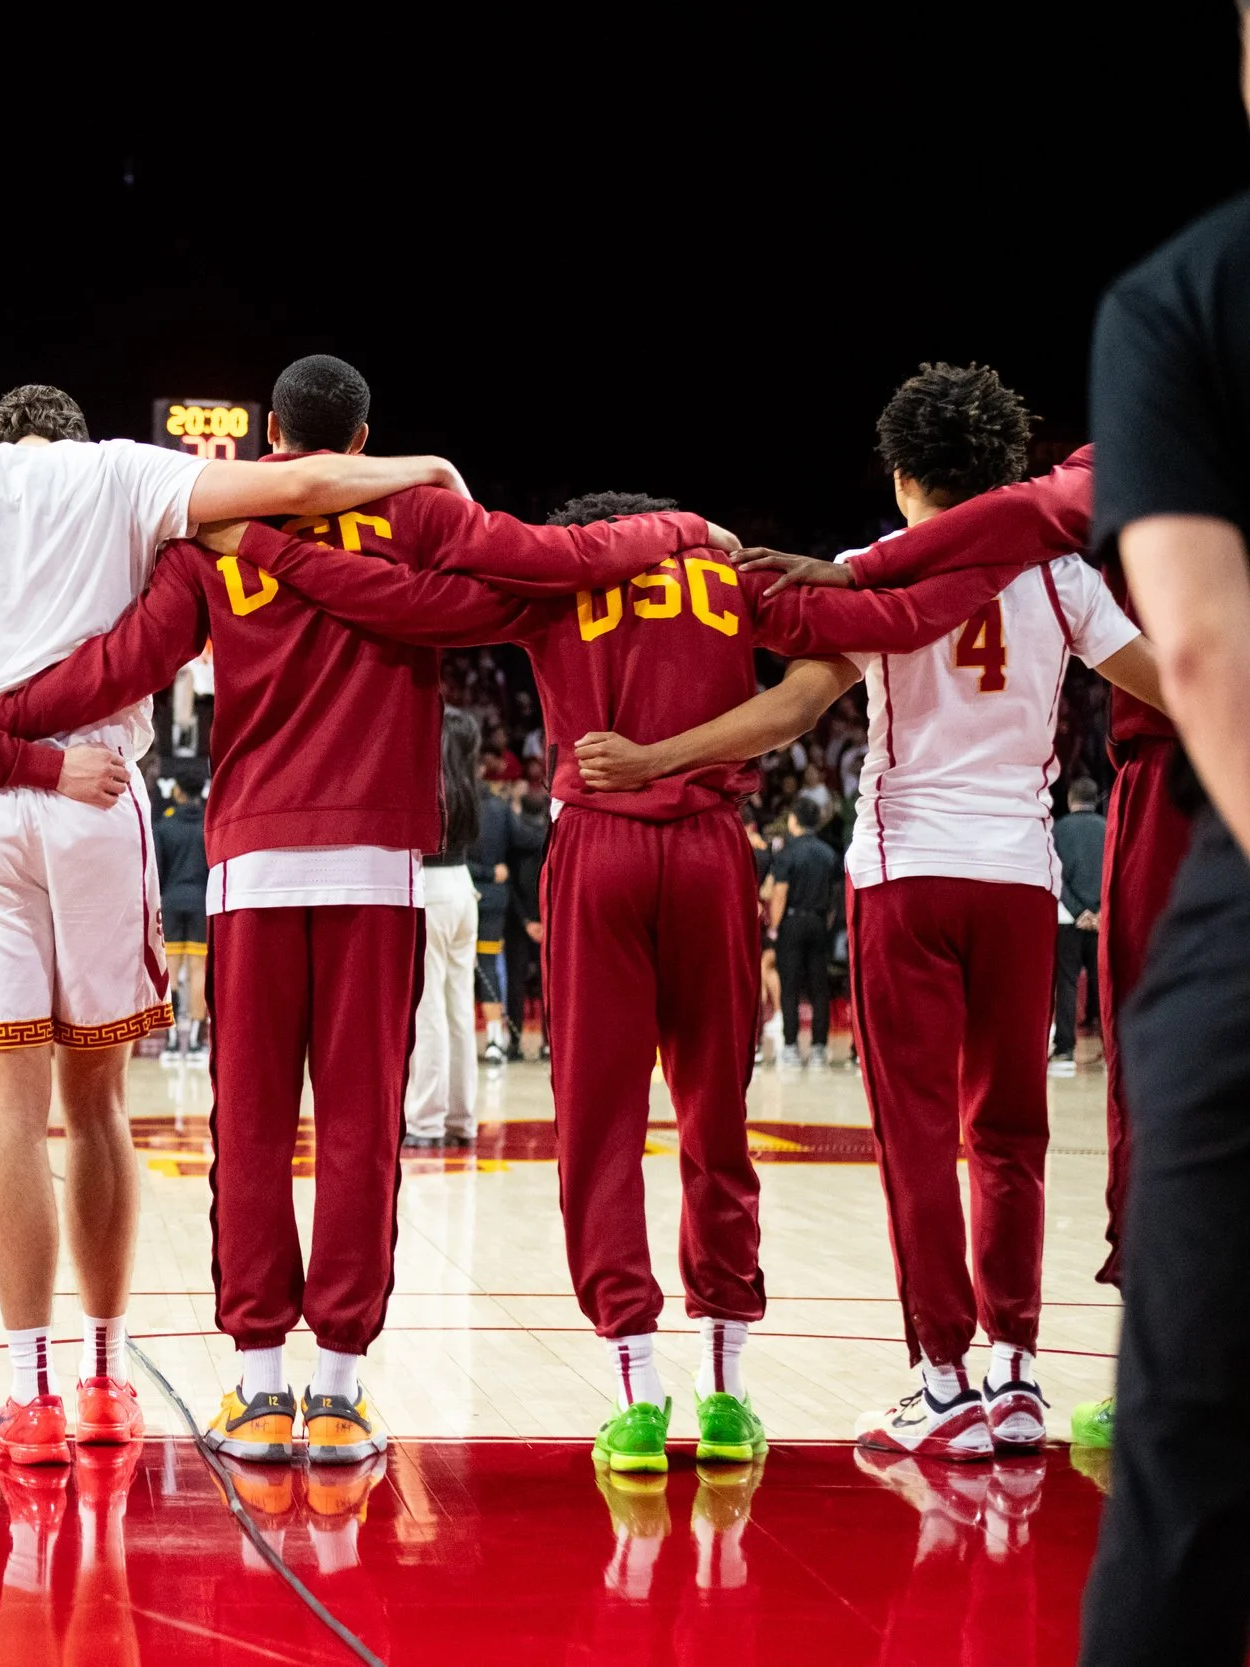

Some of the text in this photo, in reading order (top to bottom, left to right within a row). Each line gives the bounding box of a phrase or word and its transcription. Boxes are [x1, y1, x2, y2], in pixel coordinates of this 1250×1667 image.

[166, 405, 249, 438] 20:00
[576, 557, 739, 642] USC
[955, 597, 1007, 693] 4
[268, 1395, 279, 1406] 12
[322, 1398, 332, 1408] 12
